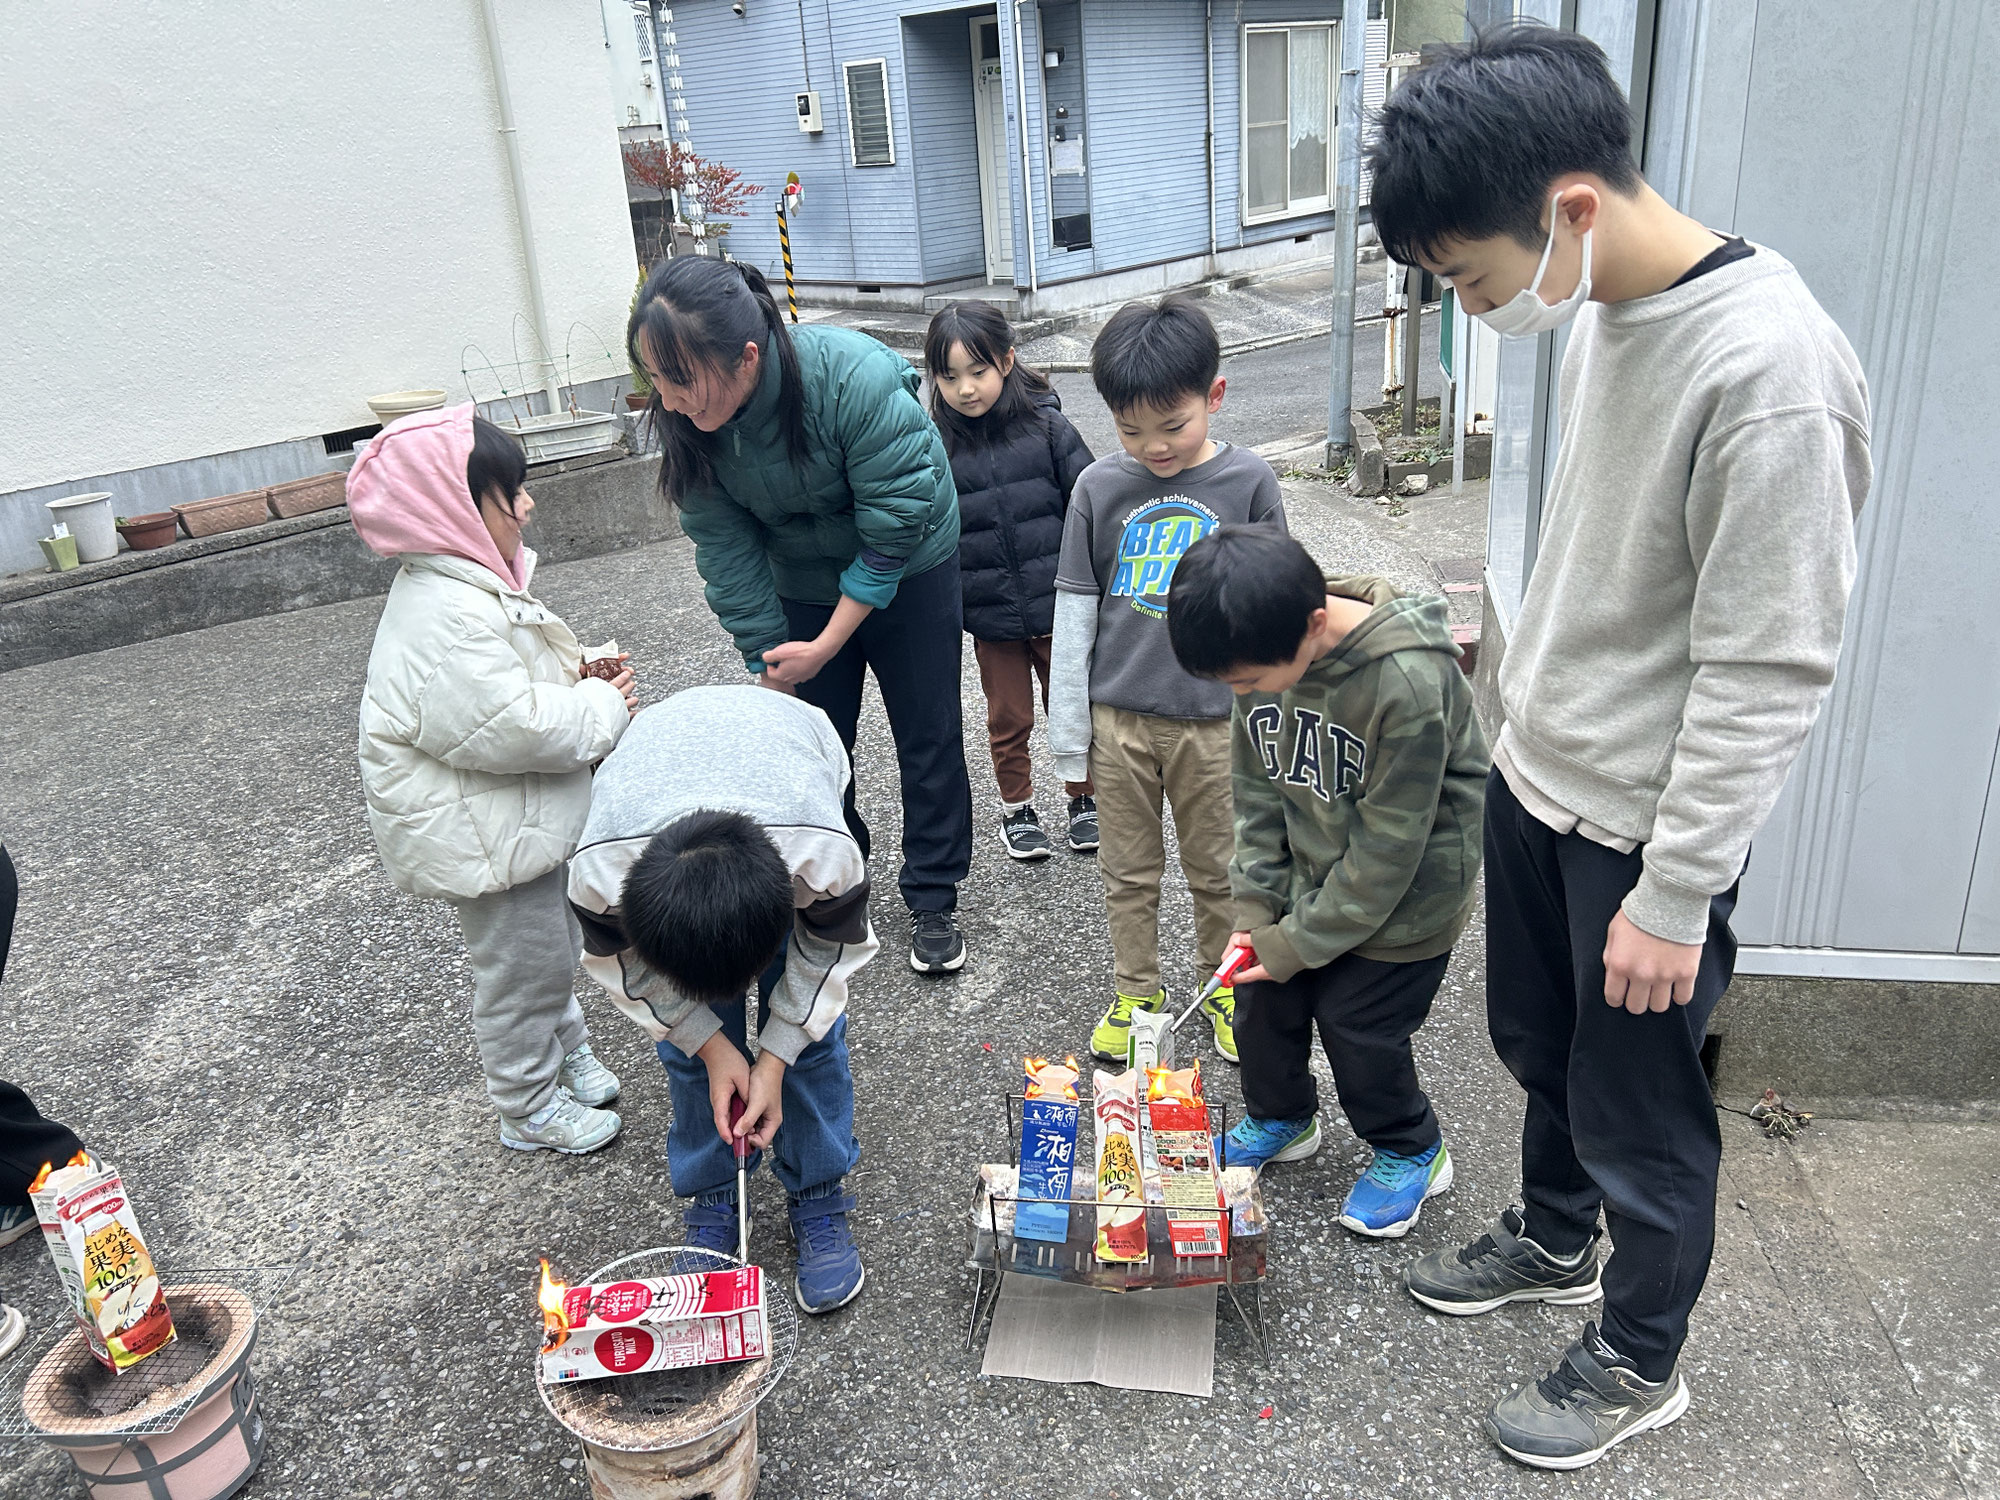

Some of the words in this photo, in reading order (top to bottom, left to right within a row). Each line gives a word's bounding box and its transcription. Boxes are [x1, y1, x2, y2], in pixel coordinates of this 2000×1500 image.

[1122, 498, 1161, 528] Authentic
[1163, 494, 1219, 521] achievement
[1125, 521, 1219, 559] BEAT
[1110, 560, 1180, 596] APA
[1130, 600, 1162, 619] Definite
[1247, 703, 1366, 803] GAP
[1103, 1140, 1133, 1153] まじめな
[1104, 1152, 1135, 1171] 果実
[1034, 1134, 1072, 1200] 湘南
[83, 1227, 129, 1257] まじめな
[89, 1238, 136, 1276] 果実
[619, 1289, 636, 1312] 牛乳
[610, 1331, 626, 1367] FURUSATO
[623, 1337, 637, 1355] MILK
